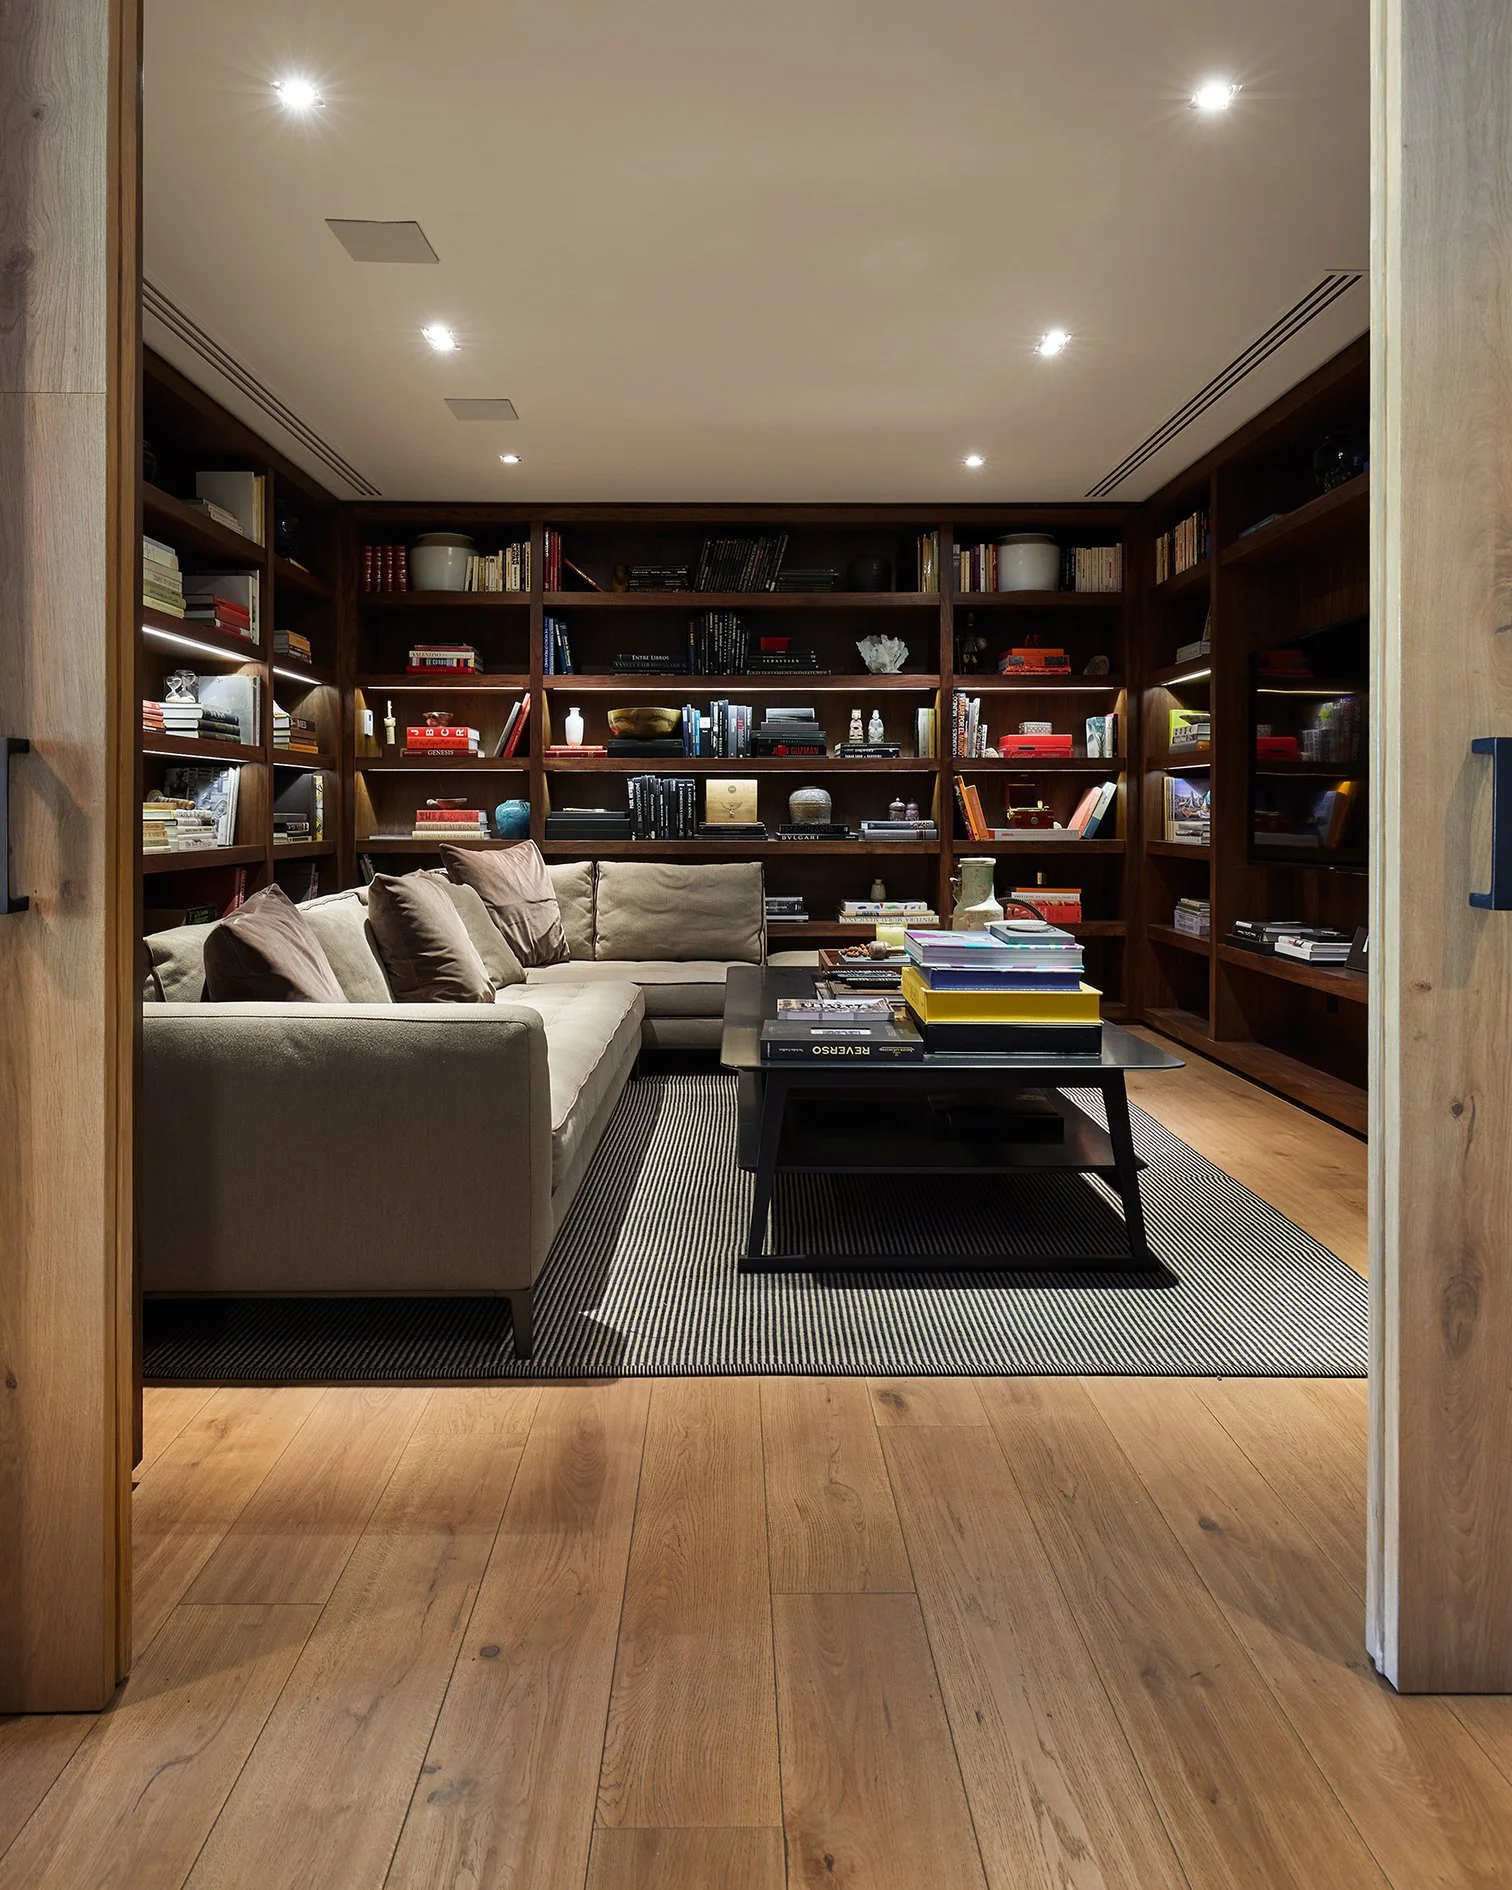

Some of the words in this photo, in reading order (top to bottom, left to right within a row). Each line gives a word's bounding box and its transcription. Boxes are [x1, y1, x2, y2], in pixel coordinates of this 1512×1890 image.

[791, 746, 819, 754] GUZMAN
[1009, 750, 1036, 758] Cartier
[812, 1046, 871, 1055] REVERSO
